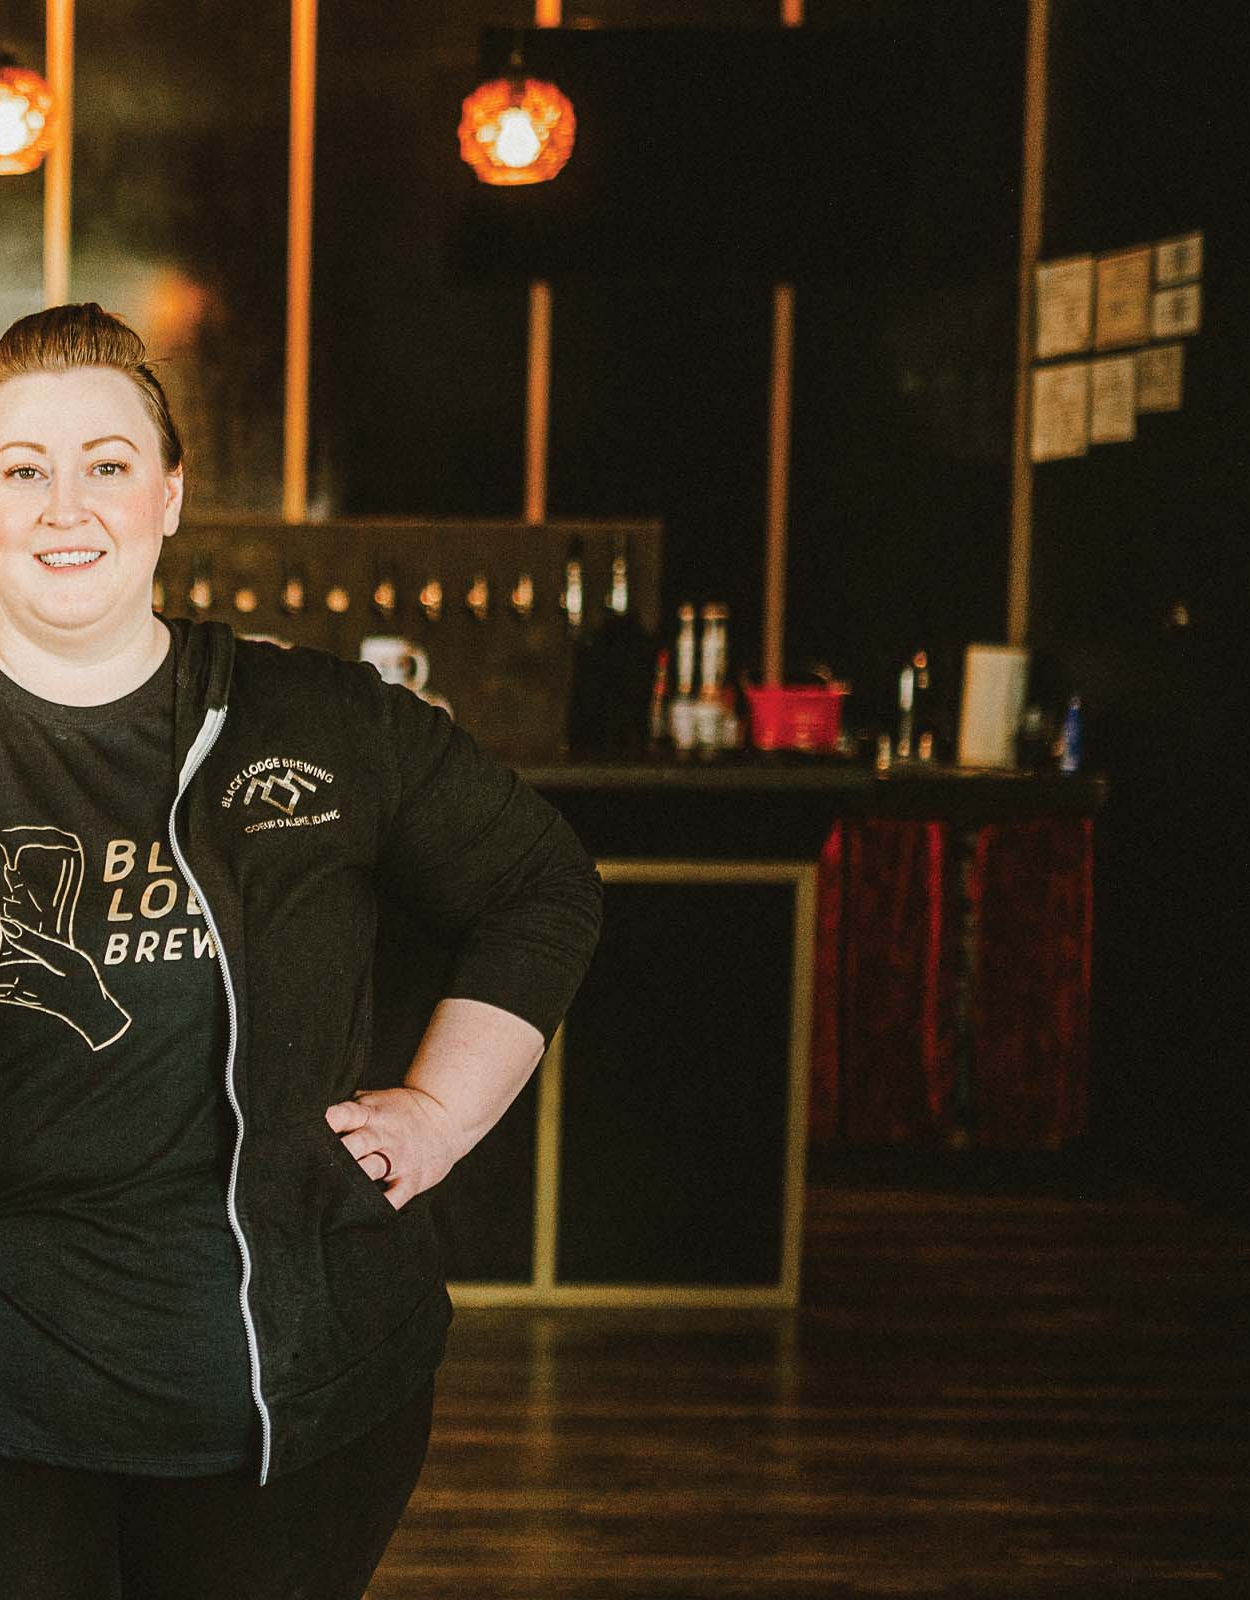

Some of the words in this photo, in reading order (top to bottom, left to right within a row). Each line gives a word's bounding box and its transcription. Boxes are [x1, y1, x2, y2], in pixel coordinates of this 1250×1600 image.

[221, 774, 244, 809] BLACK
[242, 758, 281, 779] LODGE
[281, 758, 334, 784] BREWING
